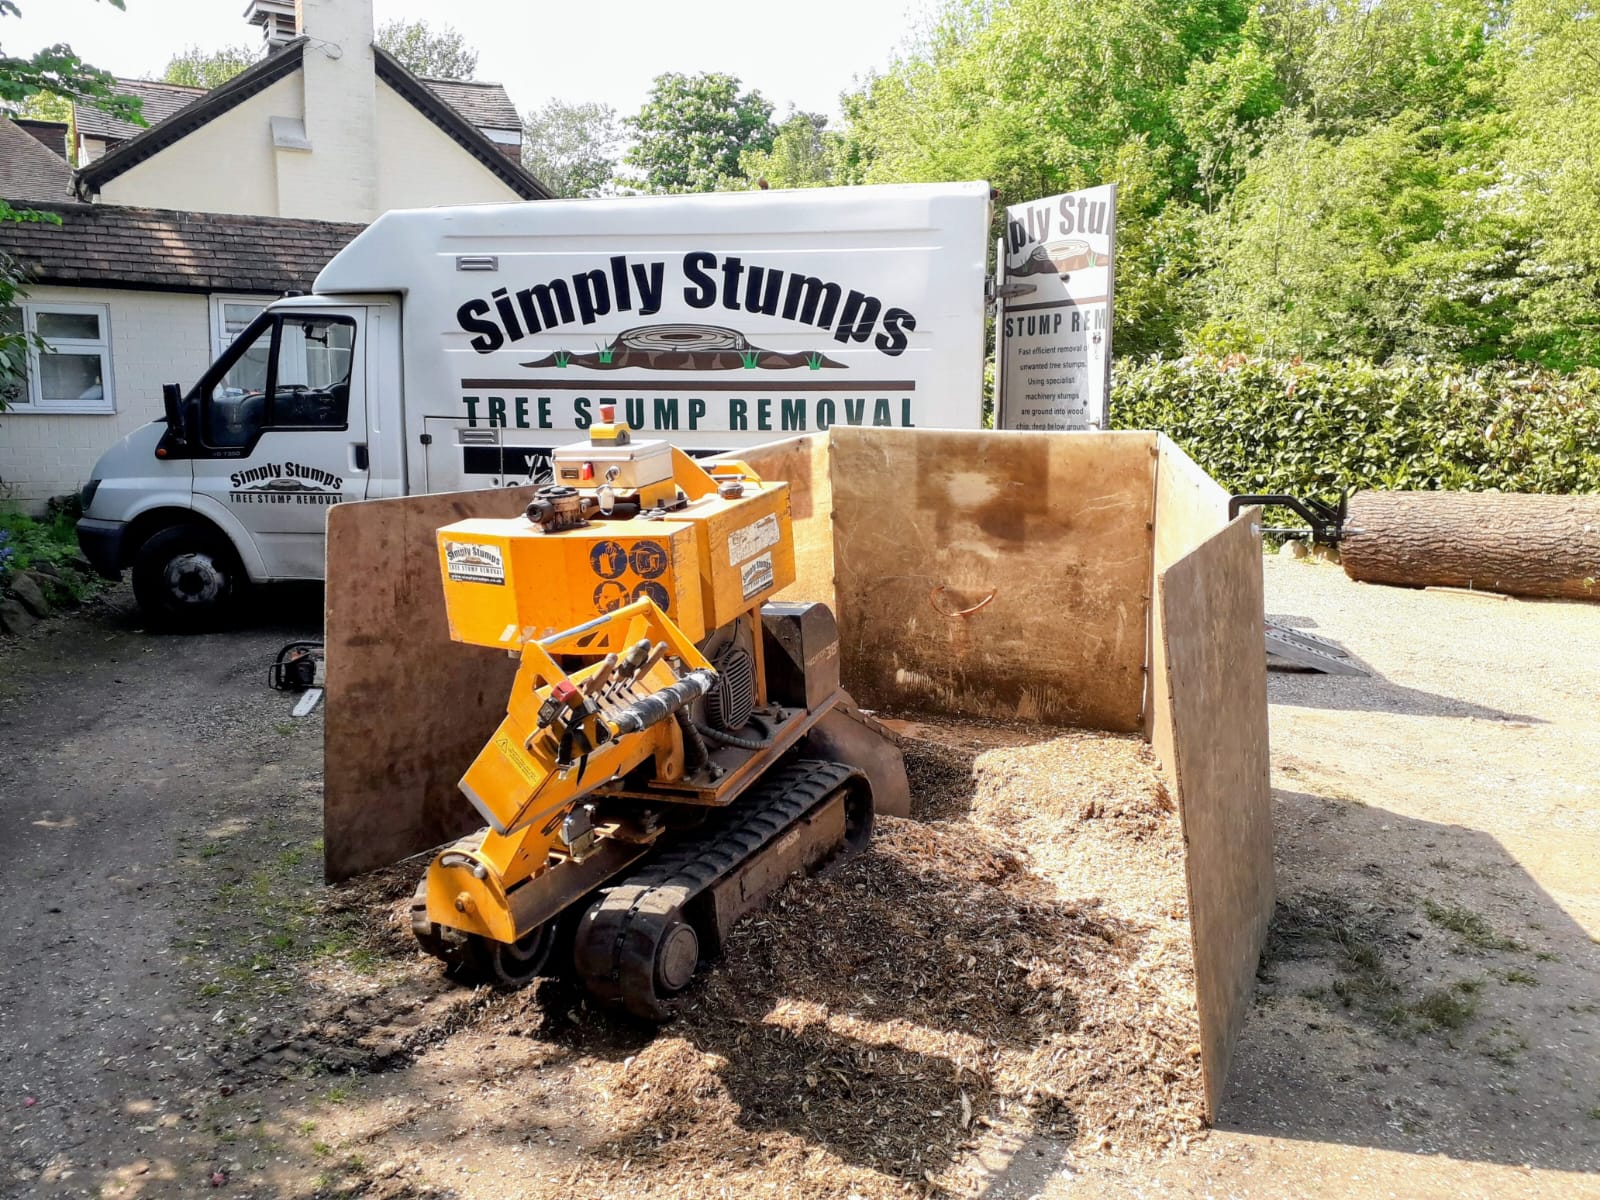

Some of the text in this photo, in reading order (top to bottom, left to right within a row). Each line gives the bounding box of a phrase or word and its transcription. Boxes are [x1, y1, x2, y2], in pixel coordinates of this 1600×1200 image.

[1060, 195, 1111, 235] Stu
[457, 251, 917, 357] Simply Stumps
[1005, 308, 1106, 338] STUMP REM
[1018, 347, 1031, 356] Fast
[1032, 346, 1056, 354] efficient
[1057, 344, 1082, 353] removal
[1020, 362, 1048, 371] unwanted
[1049, 361, 1061, 369] tree
[1028, 377, 1075, 386] Using specialist
[1025, 392, 1079, 401] machinery stumps
[462, 396, 553, 429] TREE
[729, 398, 916, 432] REMOVAL
[1032, 408, 1053, 416] ground
[1047, 422, 1065, 430] below
[230, 462, 343, 490] Simply Stumps
[230, 494, 253, 503] TREE
[258, 495, 292, 504] STUMP
